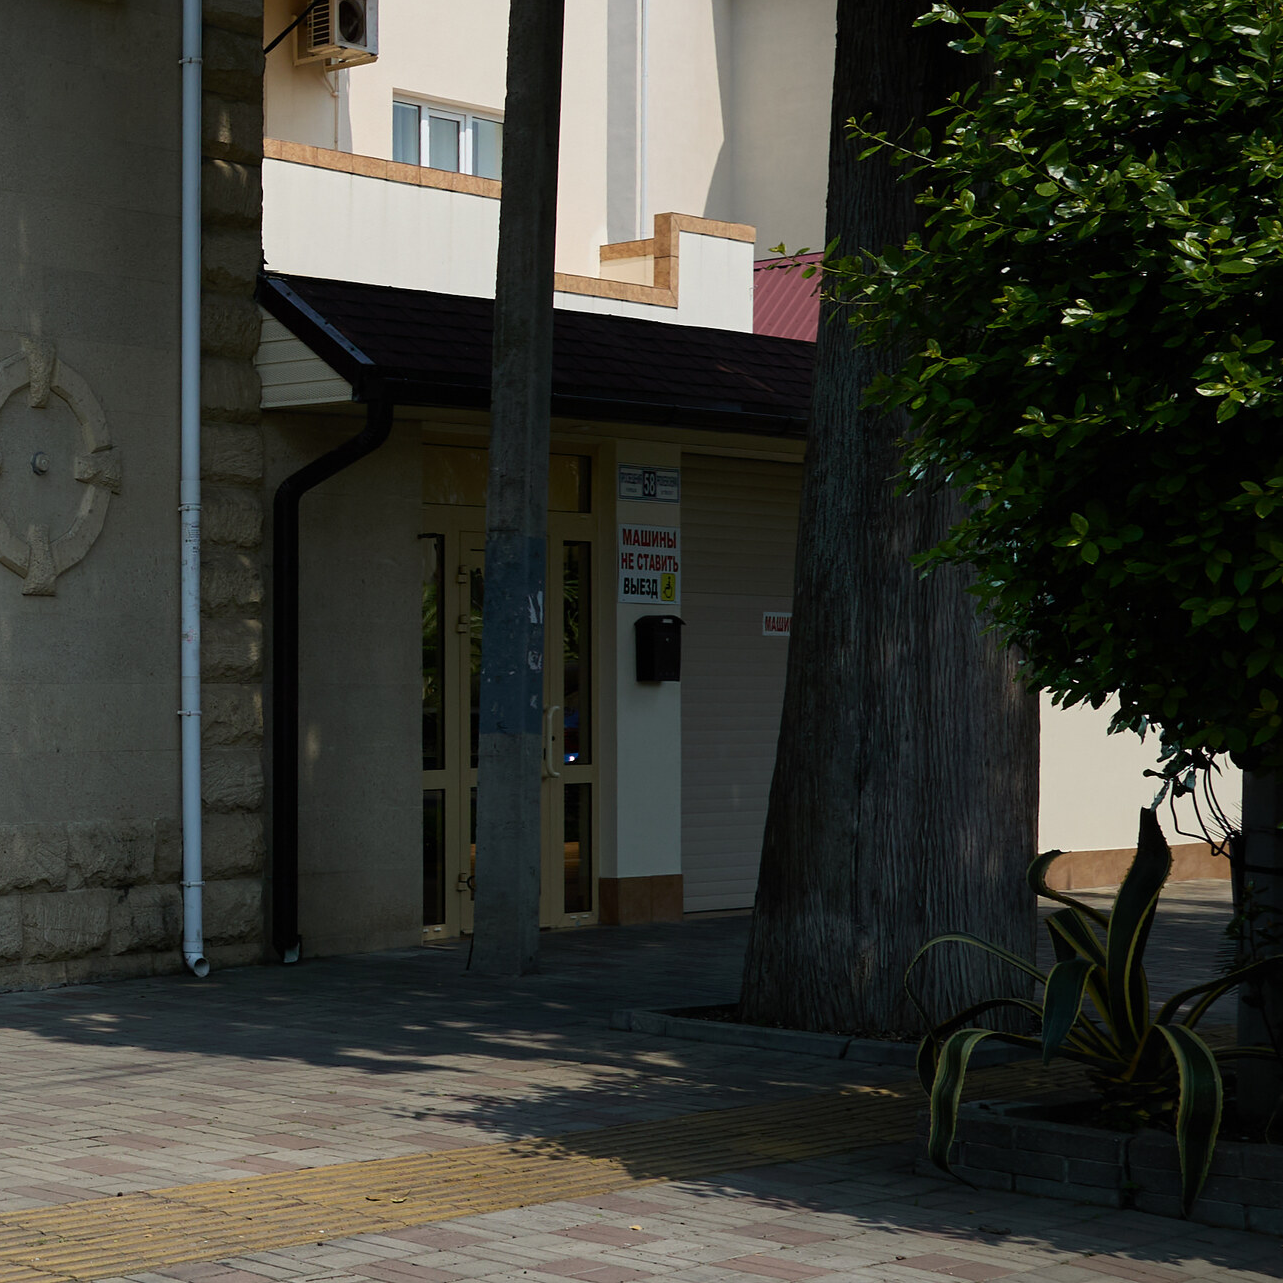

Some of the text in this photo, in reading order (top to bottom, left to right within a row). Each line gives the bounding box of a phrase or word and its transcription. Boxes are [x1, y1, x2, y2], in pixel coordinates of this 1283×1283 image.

[643, 473, 656, 495] 58
[622, 528, 677, 549] МАШИНЫ
[621, 552, 679, 572] НЕ СТАВИТЬ
[623, 577, 658, 599] ВЫЕЗД
[765, 616, 794, 632] МАШИ
